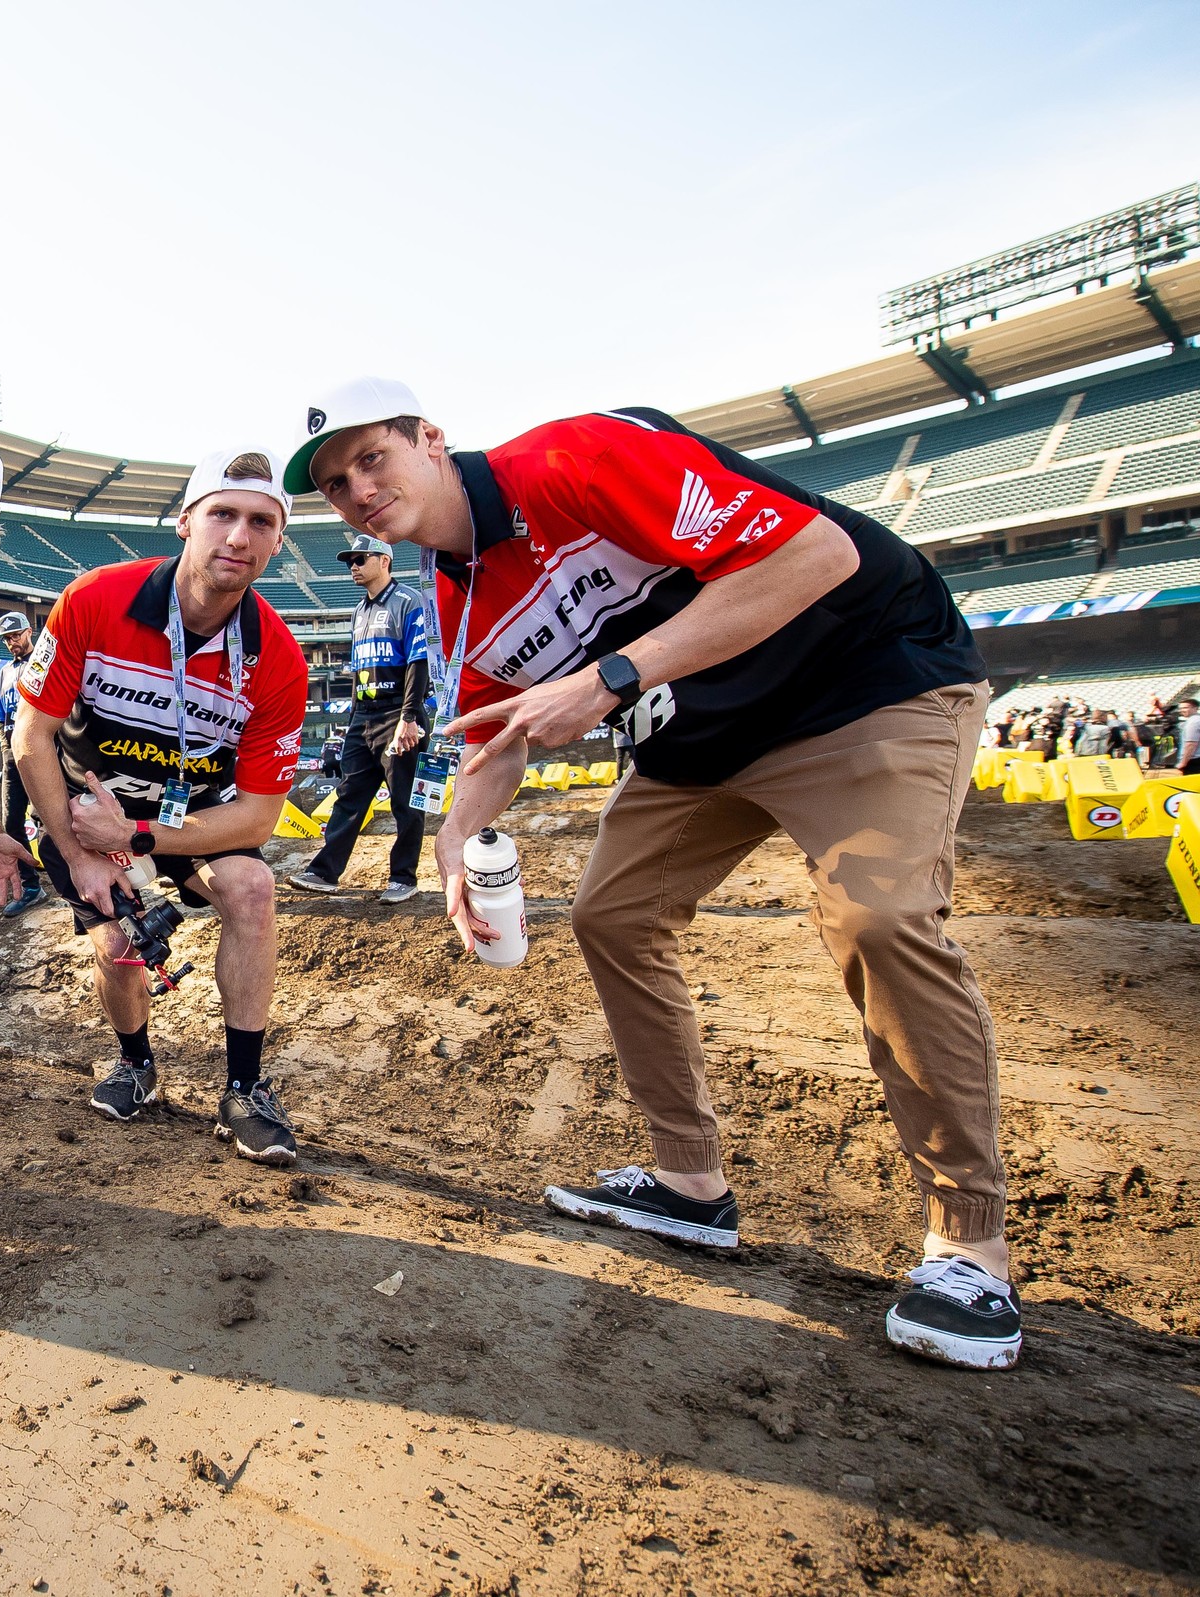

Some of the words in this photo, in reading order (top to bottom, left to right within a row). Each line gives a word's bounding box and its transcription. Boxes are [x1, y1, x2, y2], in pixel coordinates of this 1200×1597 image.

[692, 490, 753, 552] HONDA
[86, 672, 142, 711] Honda
[99, 739, 223, 774] CHAPARRAL
[291, 821, 315, 839] DUNLO
